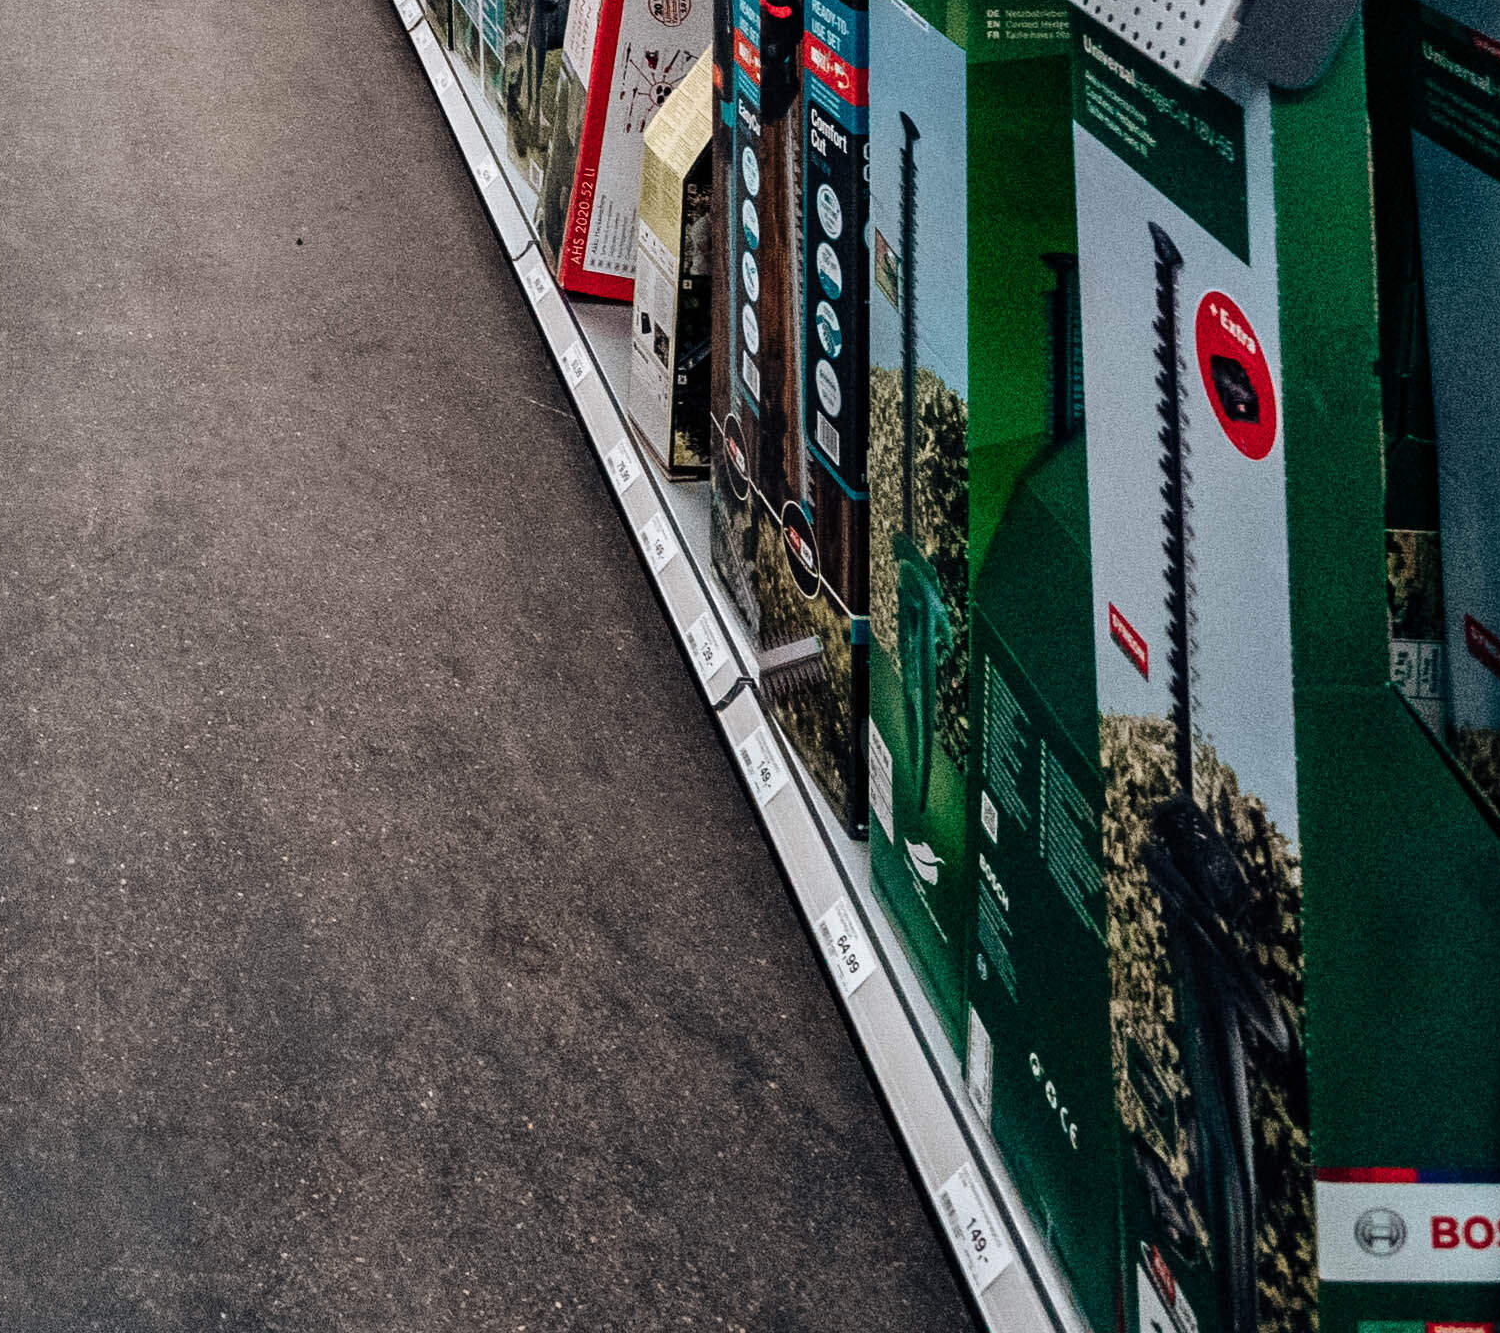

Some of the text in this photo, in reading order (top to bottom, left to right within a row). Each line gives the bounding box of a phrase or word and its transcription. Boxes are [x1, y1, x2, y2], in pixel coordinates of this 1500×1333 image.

[811, 109, 848, 155] Comfort
[811, 131, 827, 158] Cut
[571, 233, 585, 266] AHS
[1219, 307, 1258, 356] Extra
[756, 760, 774, 790] 149,-
[836, 934, 861, 976] 64,99
[966, 1216, 991, 1266] 149,-
